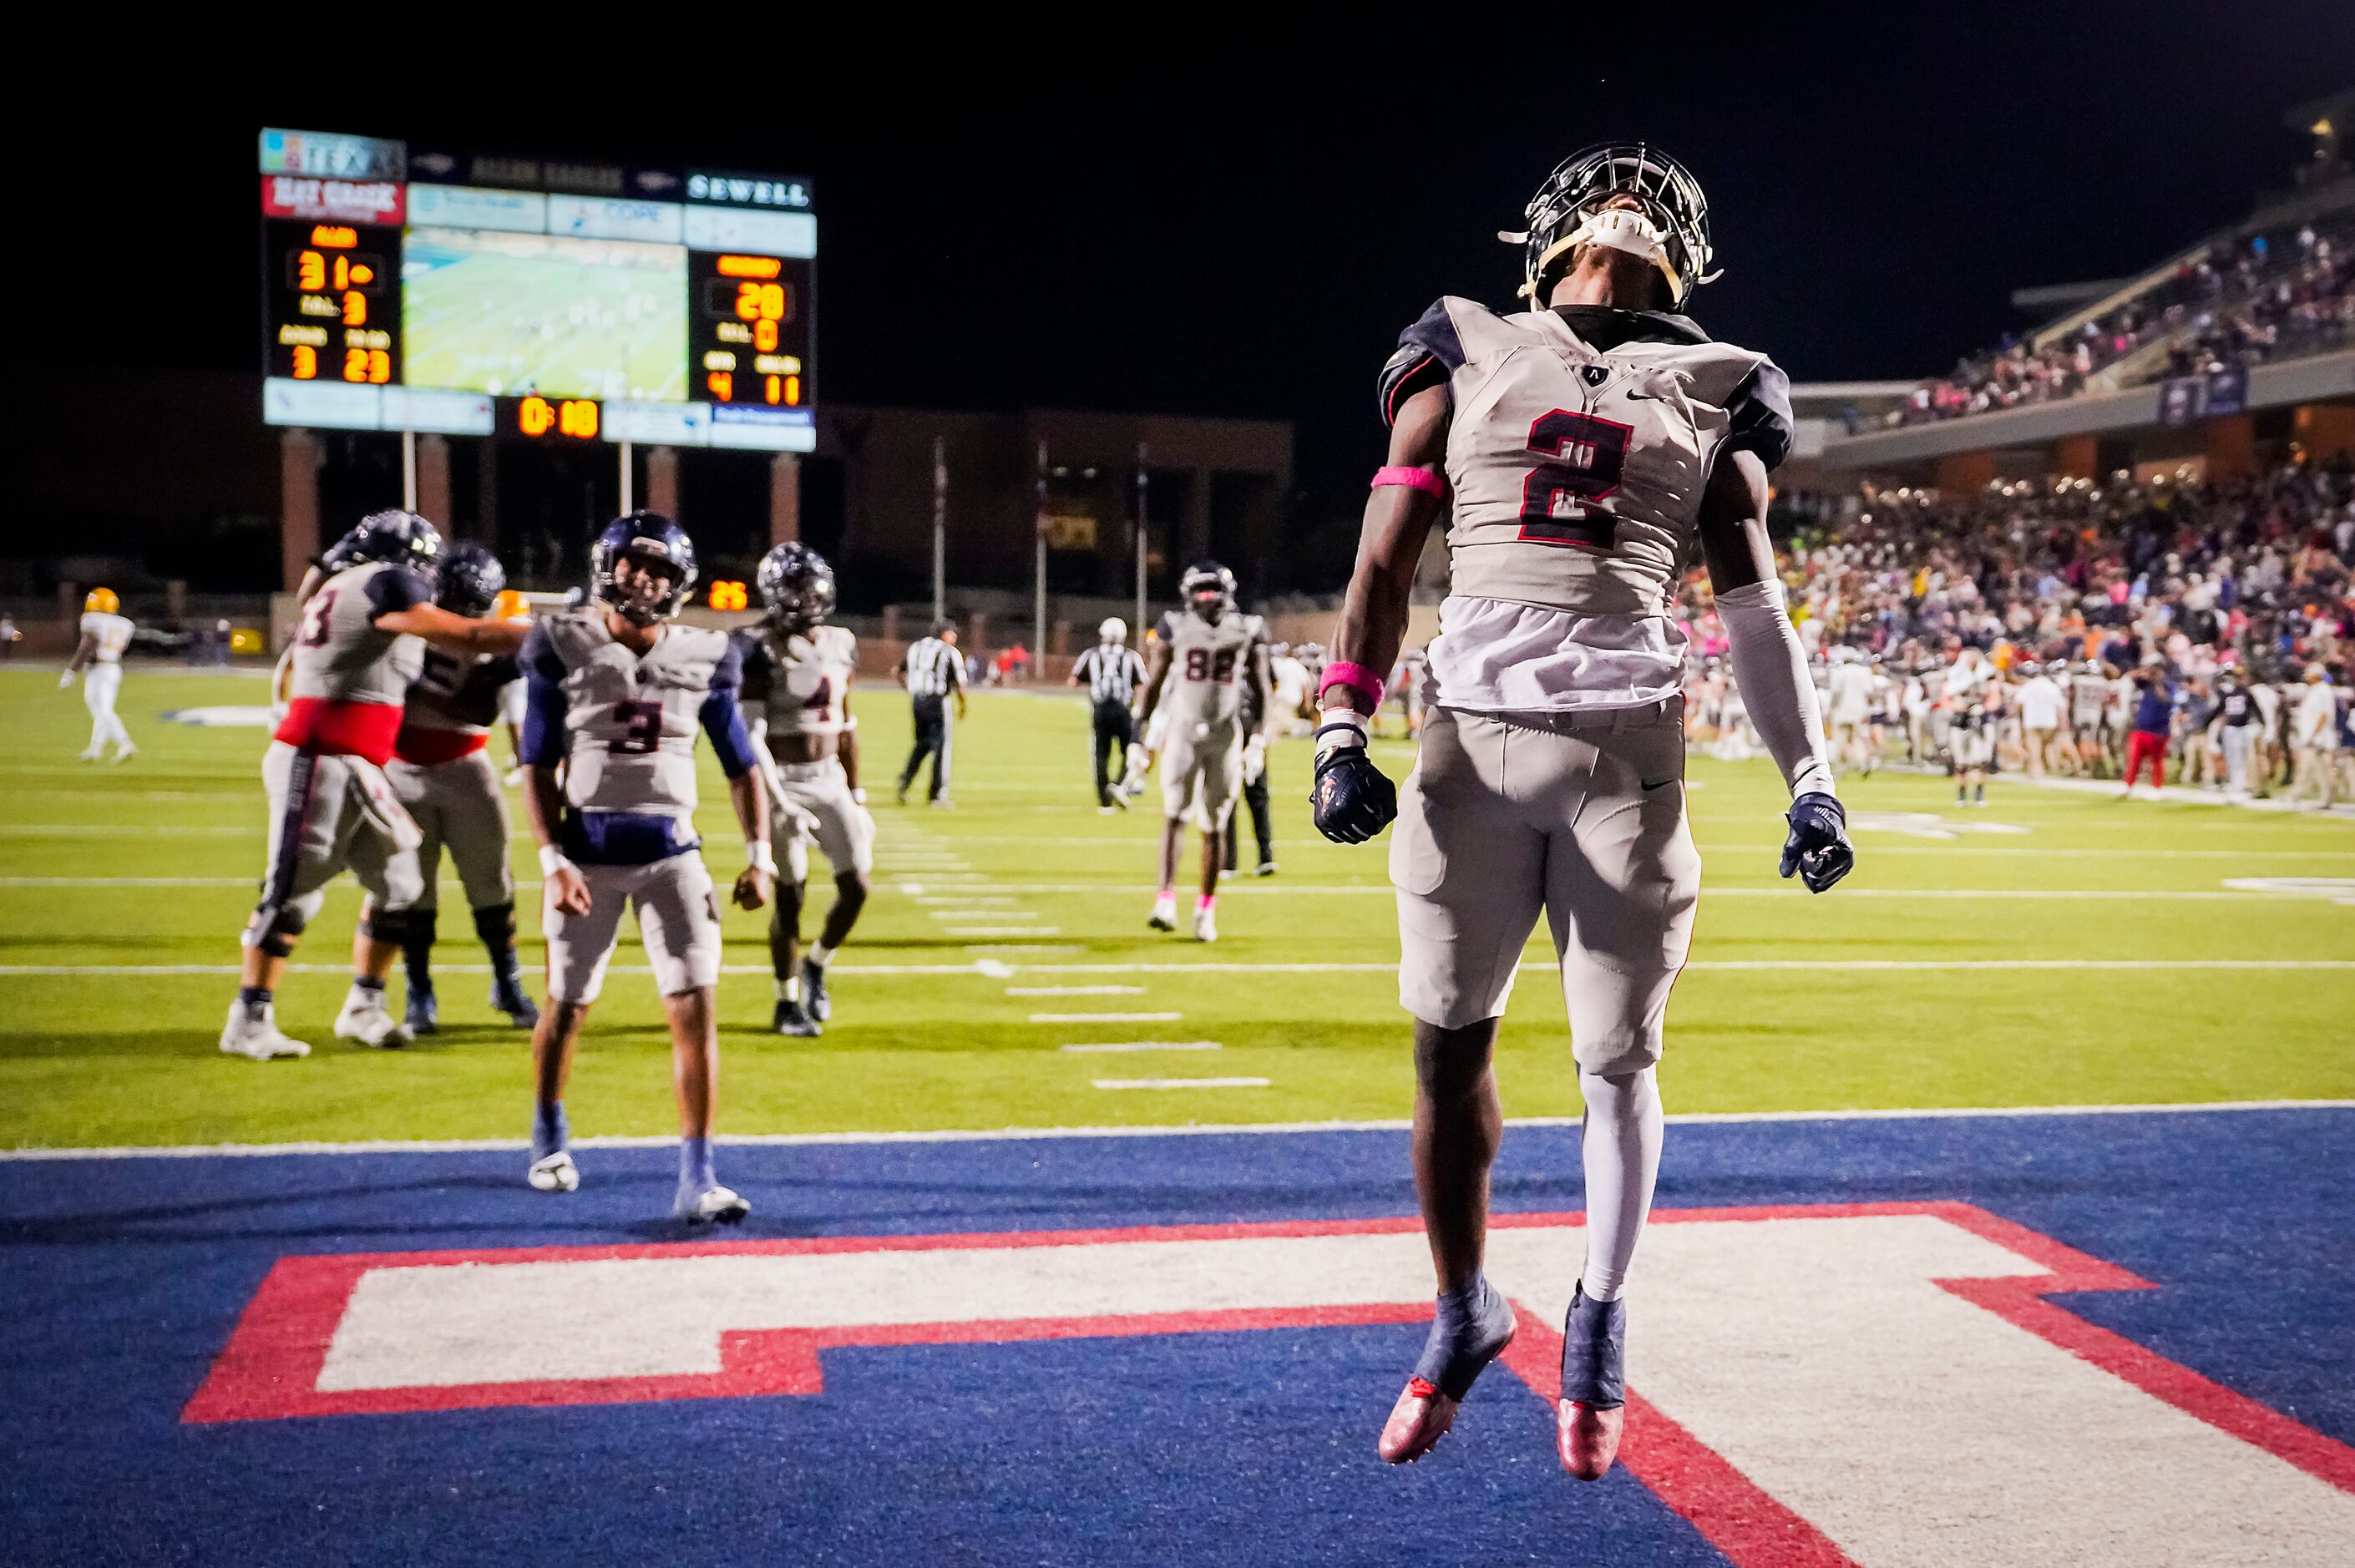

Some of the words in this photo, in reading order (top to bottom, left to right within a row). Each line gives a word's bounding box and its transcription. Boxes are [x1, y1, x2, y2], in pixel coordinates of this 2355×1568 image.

[688, 174, 809, 207] SEWELL
[708, 372, 732, 402] 4
[766, 374, 800, 406] 11
[1517, 407, 1635, 551] 2
[803, 675, 831, 722] 4
[609, 700, 662, 755] 3
